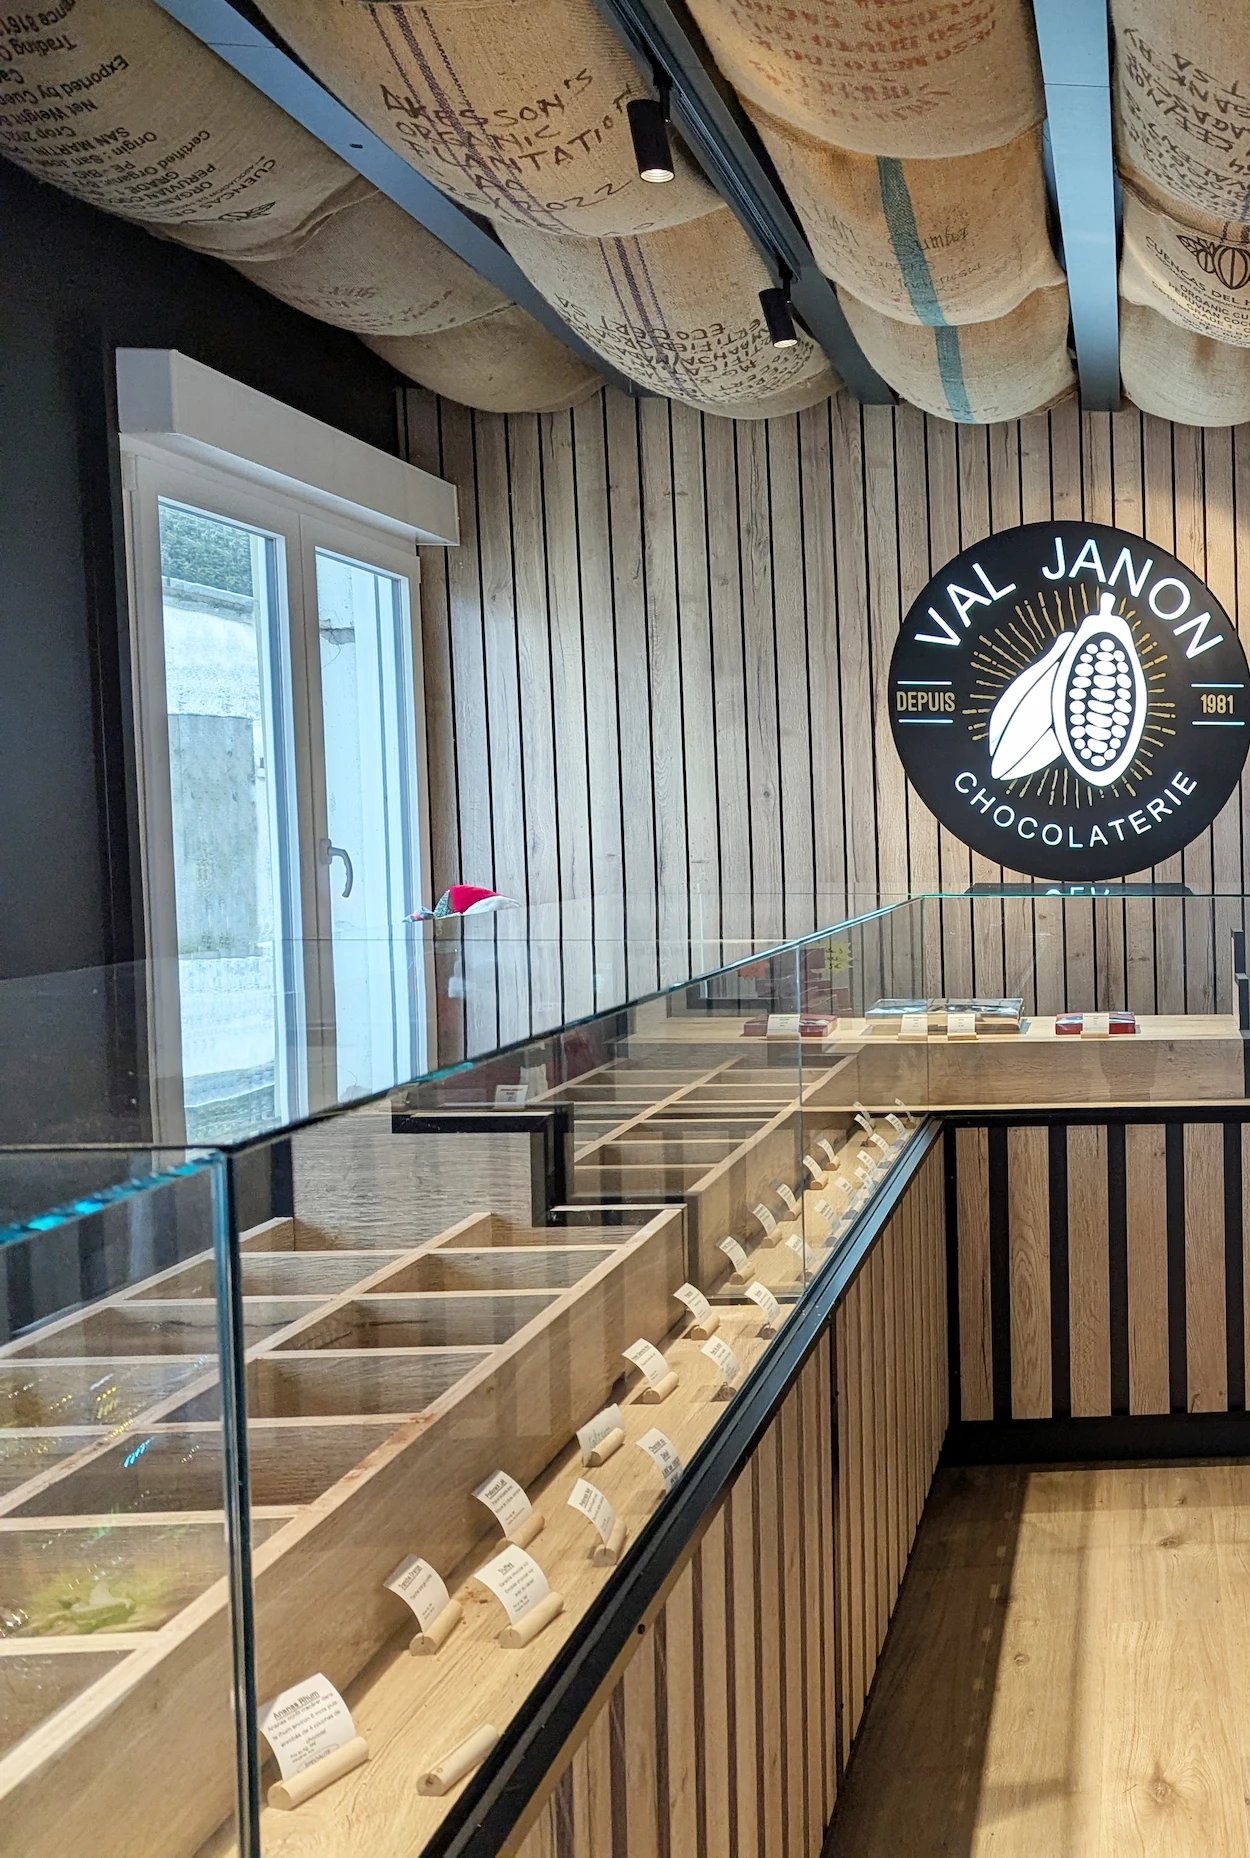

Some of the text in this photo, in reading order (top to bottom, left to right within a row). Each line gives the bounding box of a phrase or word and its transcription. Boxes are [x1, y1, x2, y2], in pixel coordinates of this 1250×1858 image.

[9, 35, 77, 56] Trading
[60, 55, 129, 97] Exported
[37, 84, 63, 99] by
[94, 127, 130, 146] SAN
[157, 130, 210, 171] Certified
[1146, 236, 1206, 292] CUENCAS
[1211, 289, 1242, 306] DEL
[1168, 281, 1221, 319] PERUVIAN
[1180, 284, 1229, 316] ORGANIC
[662, 318, 761, 353] ERTIFIED
[913, 536, 1225, 660] VAL JANON
[895, 690, 956, 713] DEPUIS
[1199, 693, 1235, 715] 1981
[953, 770, 1198, 849] CHOCOLATERIE
[498, 1562, 515, 1575] Truffes
[273, 1691, 320, 1720] Ananas Rhum
[306, 1729, 327, 1744] chocolat
